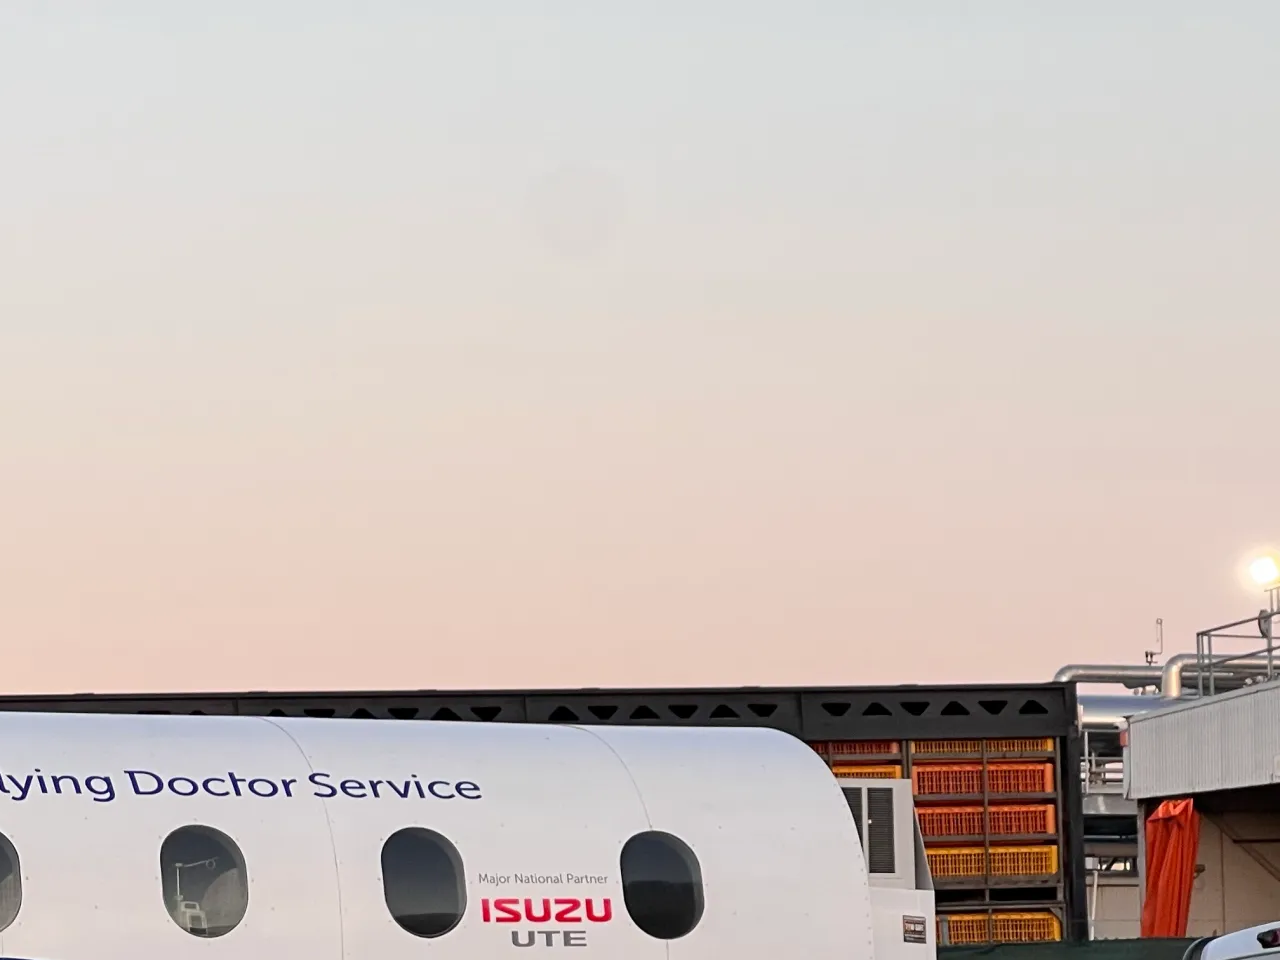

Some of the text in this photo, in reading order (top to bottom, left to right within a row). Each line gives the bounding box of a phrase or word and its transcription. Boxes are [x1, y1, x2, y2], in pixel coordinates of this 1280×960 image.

[123, 770, 297, 797] Doctor
[308, 772, 483, 800] Service
[478, 873, 608, 887] Major National Partner
[481, 898, 612, 923] ISUZU
[511, 930, 587, 947] UTE
